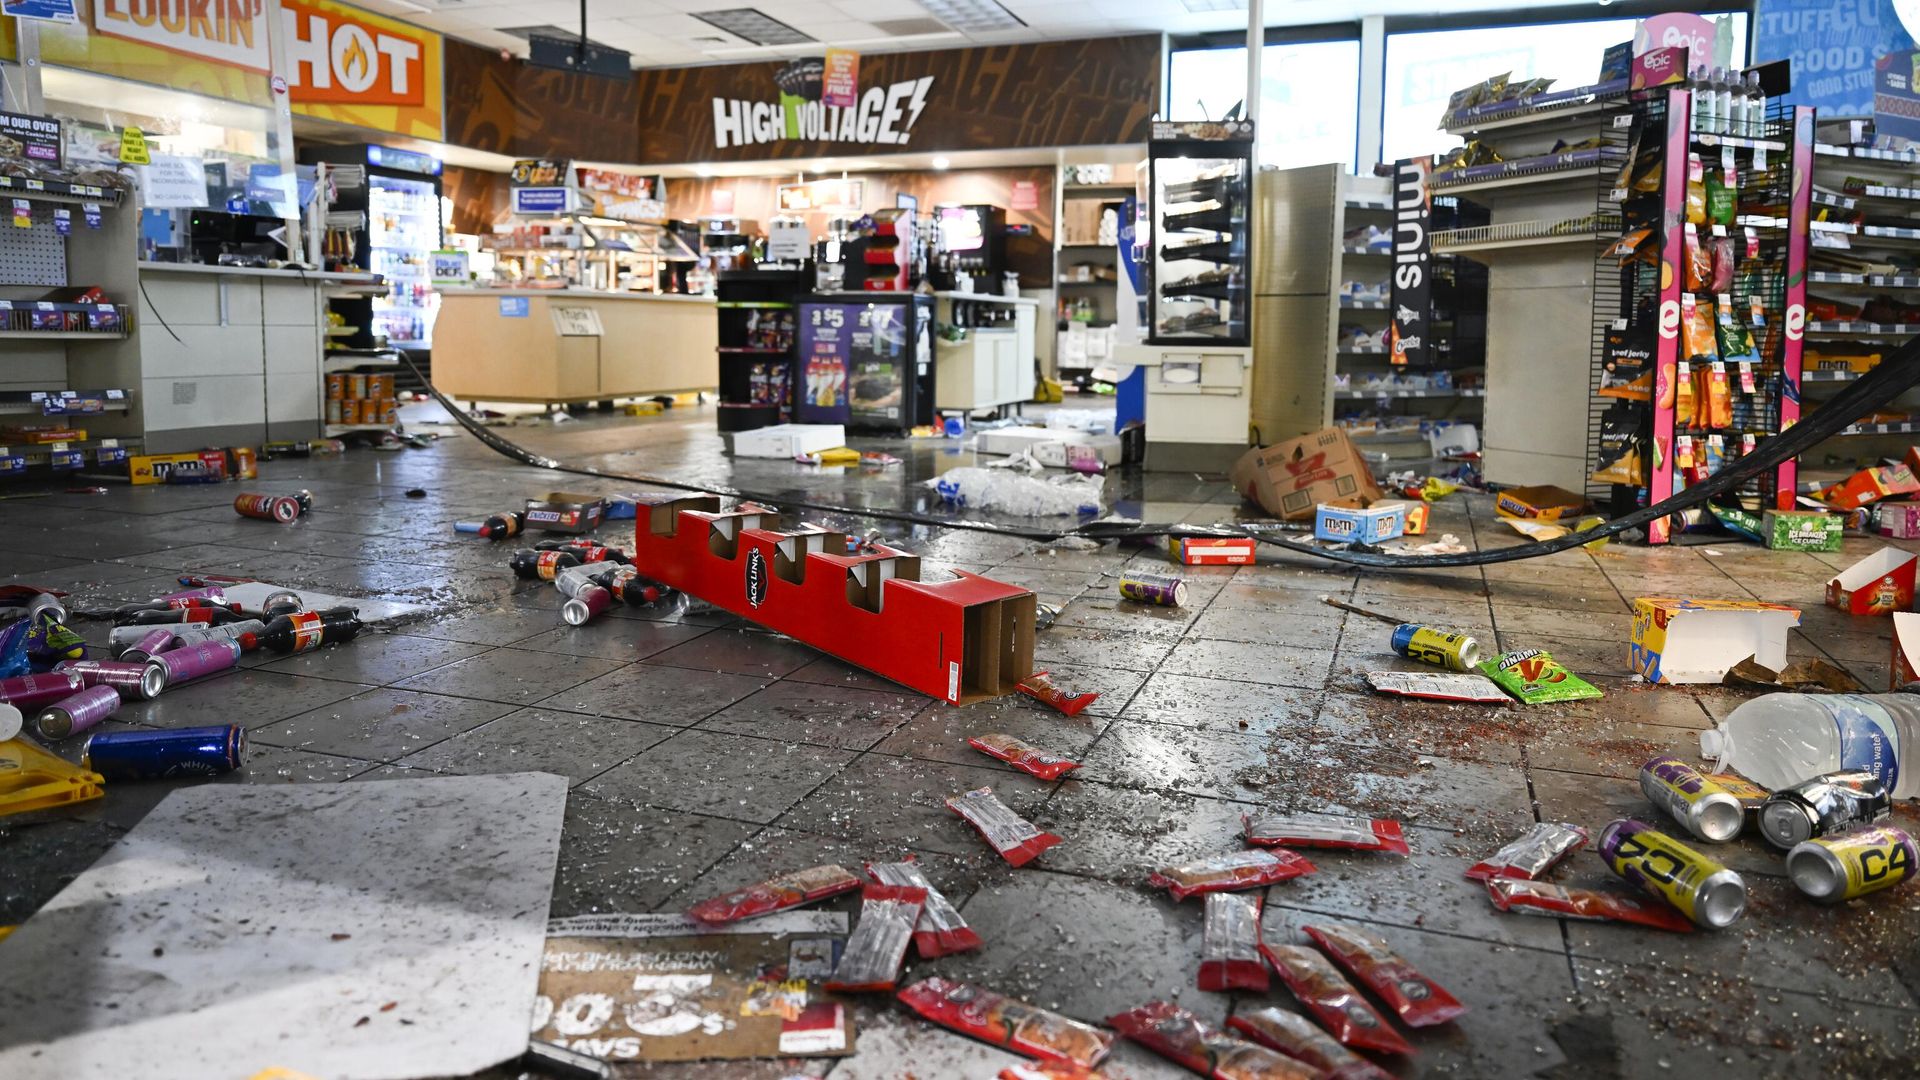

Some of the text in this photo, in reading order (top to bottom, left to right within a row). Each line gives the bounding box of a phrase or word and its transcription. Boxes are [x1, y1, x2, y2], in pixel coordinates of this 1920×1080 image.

[284, 9, 419, 95] HOT
[1644, 53, 1671, 70] epic
[1790, 46, 1866, 74] GOOD
[1807, 76, 1842, 99] GOOD
[11, 117, 31, 129] OUR
[32, 122, 58, 134] OVEN
[713, 97, 787, 149] HIGH
[25, 131, 45, 139] Cookie
[1395, 162, 1428, 290] minis
[824, 308, 844, 328] $5
[1627, 349, 1650, 360] jerky
[52, 398, 66, 409] $4
[528, 511, 560, 521] SNICKERS
[1788, 530, 1828, 541] ICE BREAKERS
[750, 547, 760, 610] JACK LINK'S
[1873, 732, 1882, 760] water
[1613, 831, 1686, 886] C4
[1860, 842, 1908, 883] C4
